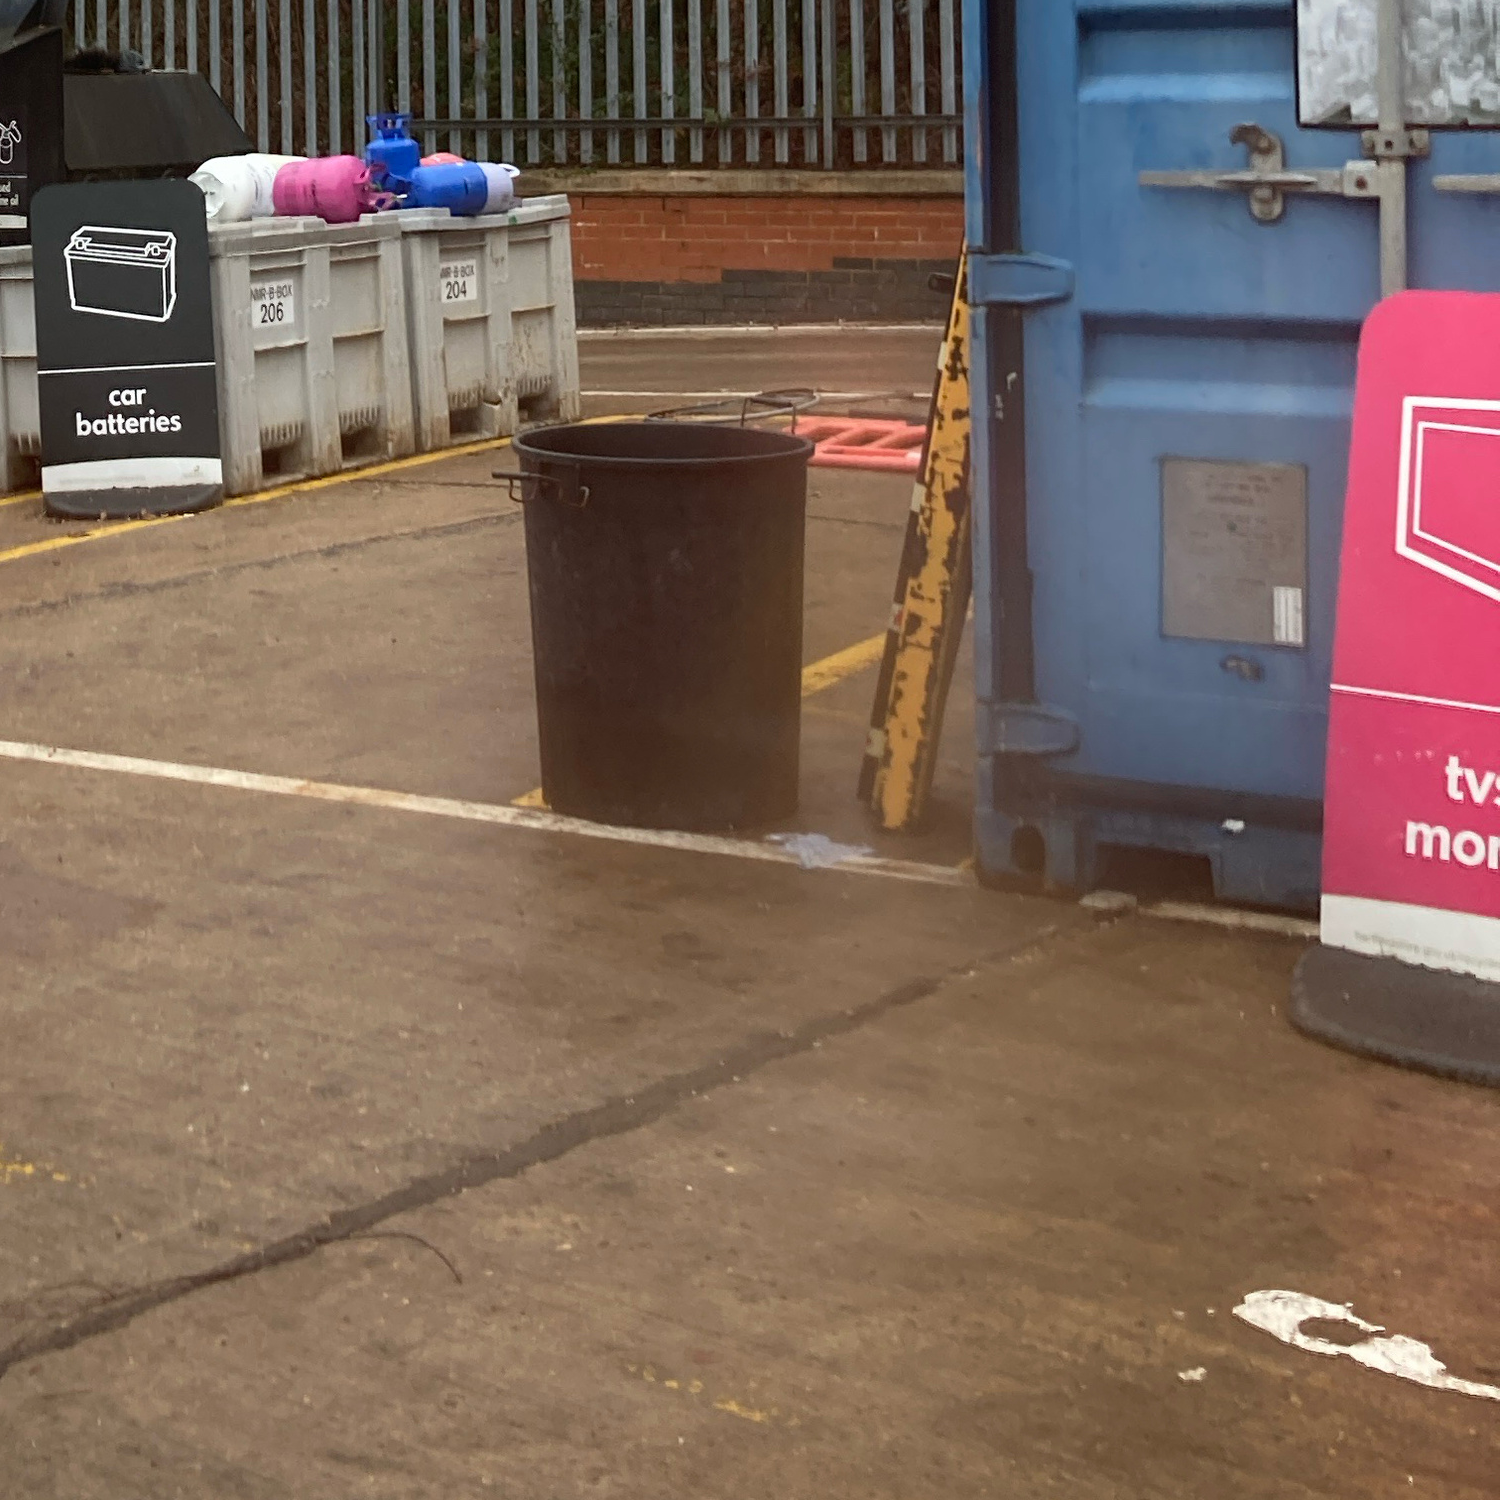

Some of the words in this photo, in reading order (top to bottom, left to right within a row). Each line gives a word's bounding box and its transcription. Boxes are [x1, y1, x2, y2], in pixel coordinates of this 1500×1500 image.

[445, 280, 467, 300] 204
[260, 301, 284, 324] 206
[108, 388, 147, 407] car
[75, 408, 182, 436] batteries
